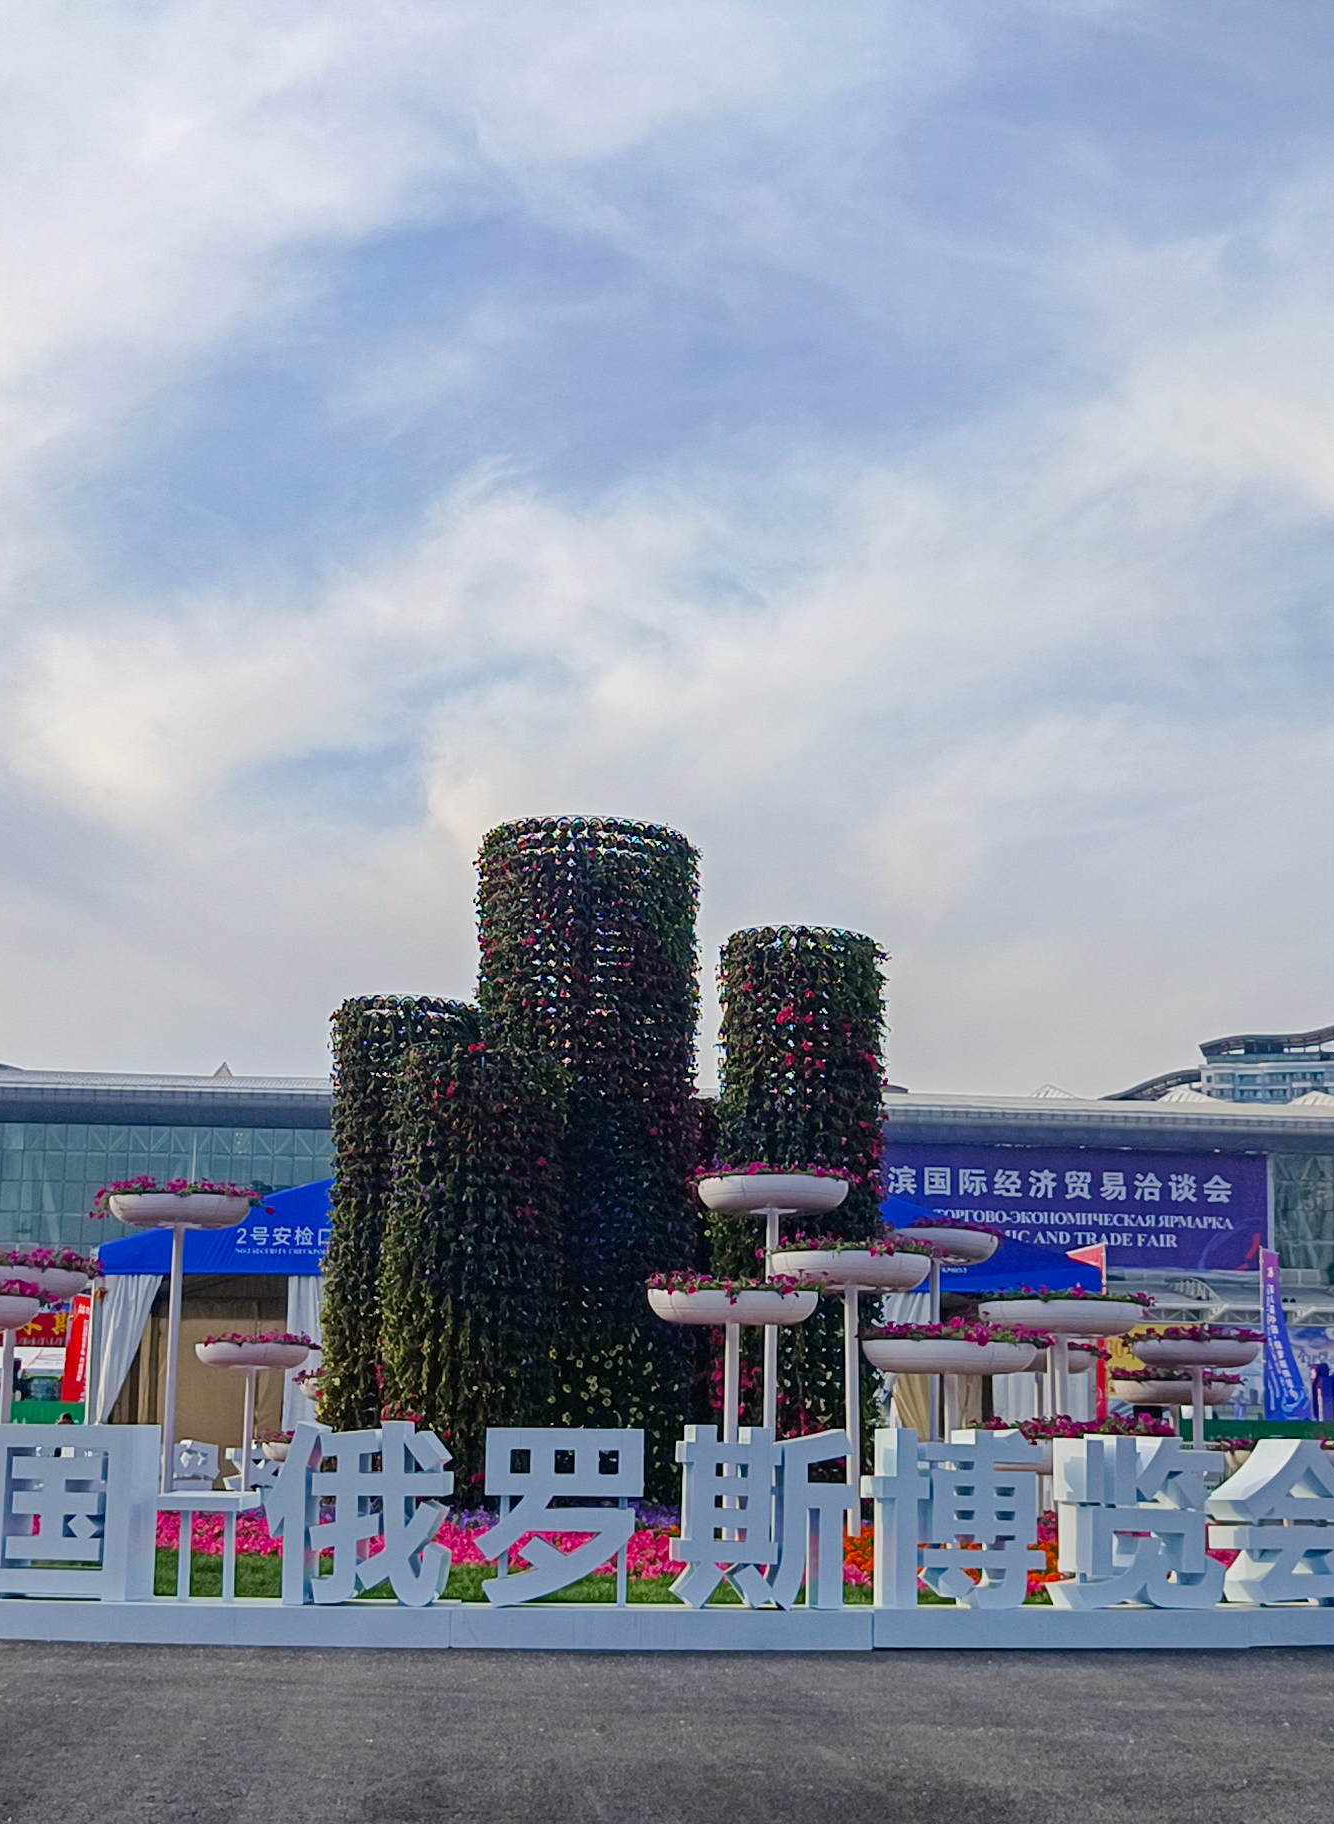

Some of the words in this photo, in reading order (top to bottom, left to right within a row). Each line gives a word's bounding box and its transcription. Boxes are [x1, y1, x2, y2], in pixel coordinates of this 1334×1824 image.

[1157, 1214, 1234, 1230] ЯРМАРКА
[236, 1226, 332, 1247] 2号安检口
[1033, 1230, 1070, 1244] AND
[1073, 1231, 1133, 1247] TRADE
[1137, 1232, 1178, 1248] FAIR
